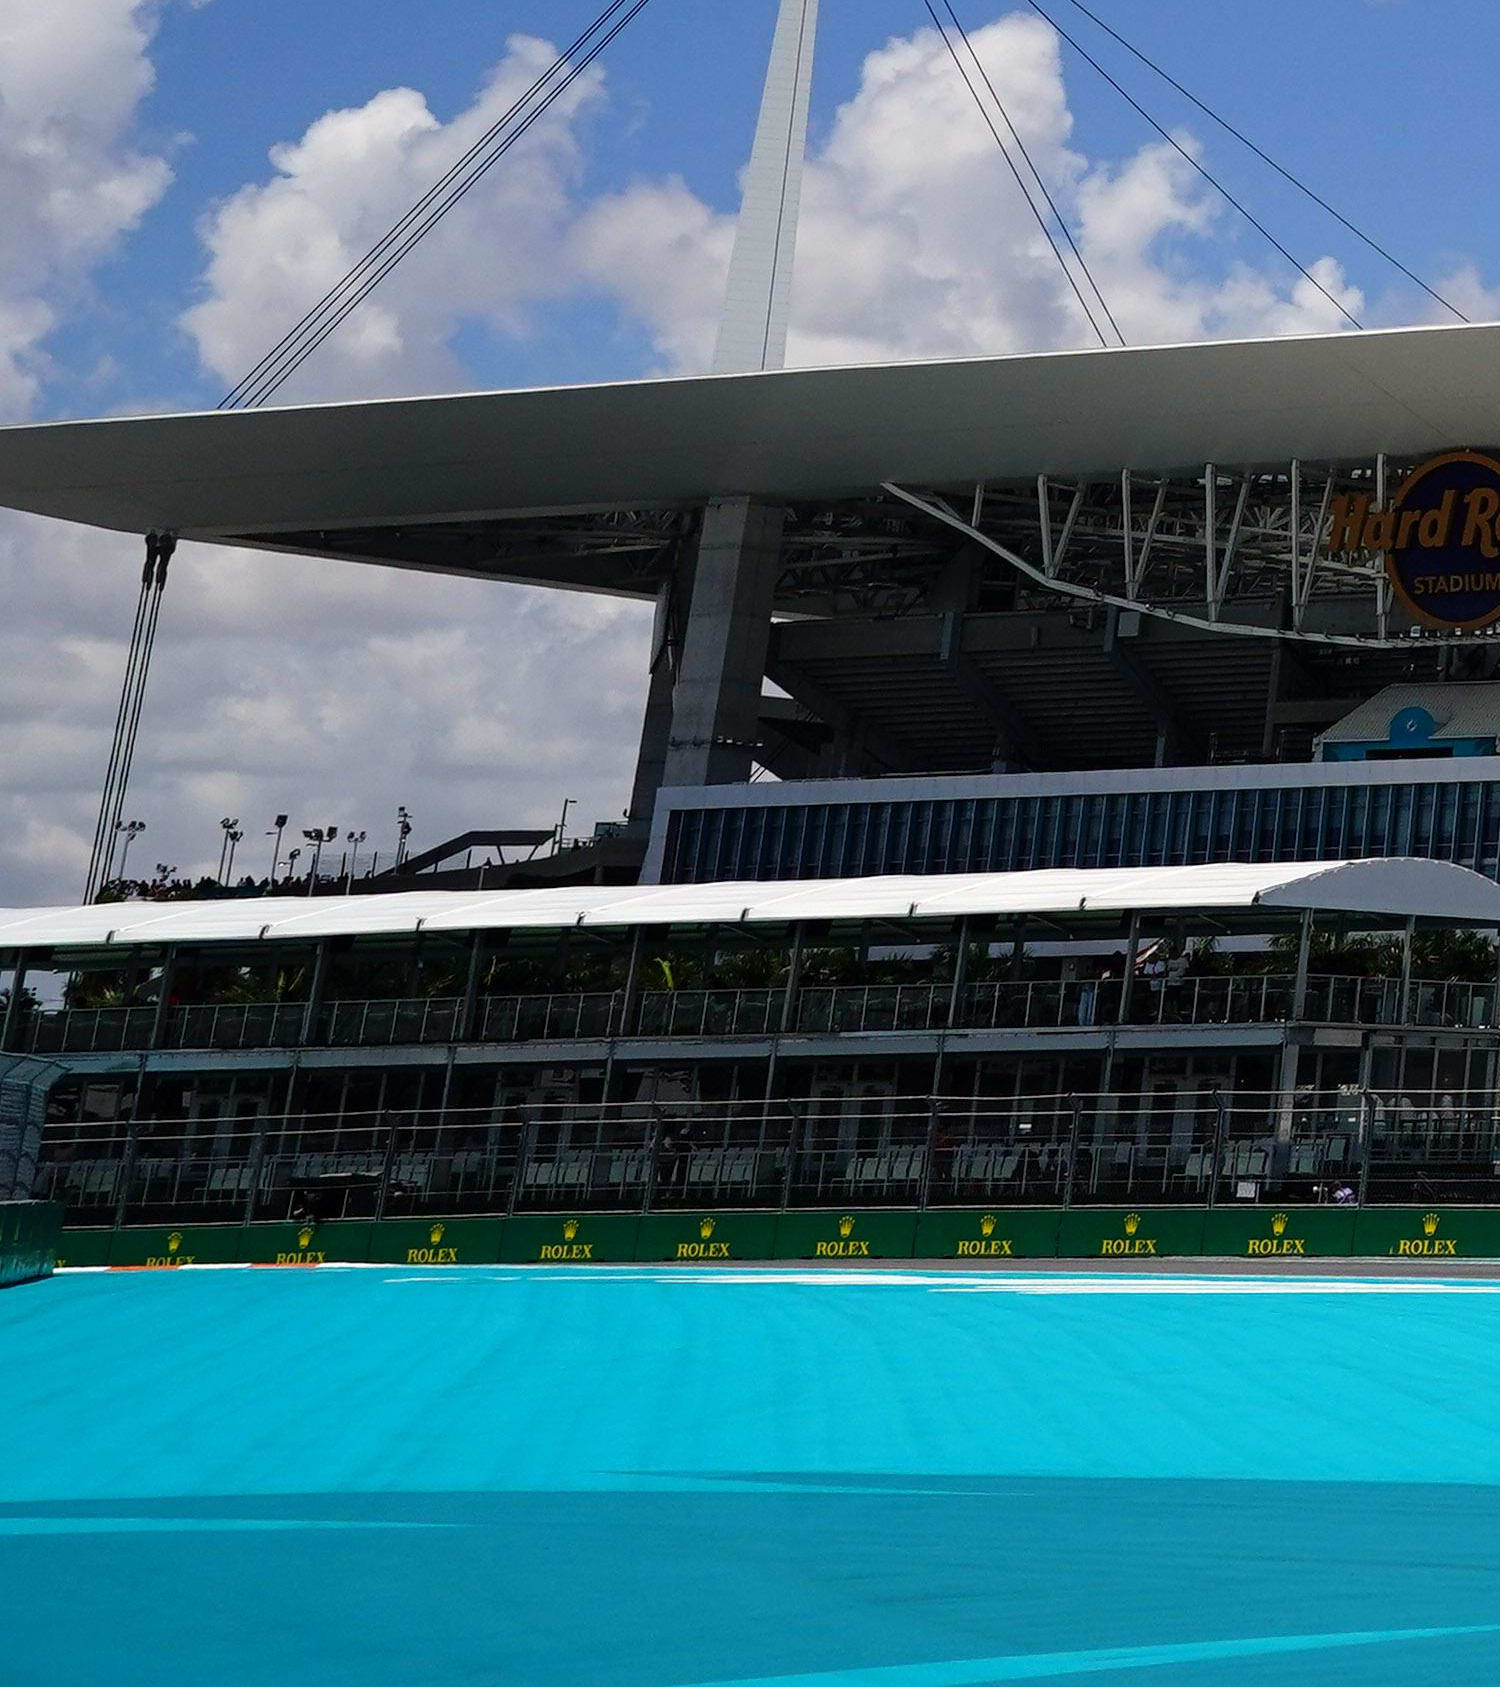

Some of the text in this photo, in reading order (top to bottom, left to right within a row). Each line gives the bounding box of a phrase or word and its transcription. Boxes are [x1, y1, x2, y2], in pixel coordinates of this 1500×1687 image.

[1328, 488, 1457, 553] Hard
[540, 1244, 592, 1259] ROLEX
[677, 1243, 729, 1257] ROLEX
[816, 1241, 869, 1256] ROLEX
[957, 1240, 1012, 1255] ROLEX
[1101, 1239, 1155, 1254] ROLEX
[1248, 1239, 1304, 1255] ROLEX
[1399, 1239, 1456, 1255] ROLEX
[276, 1251, 326, 1265] ROLEX
[407, 1248, 456, 1263] ROLEX
